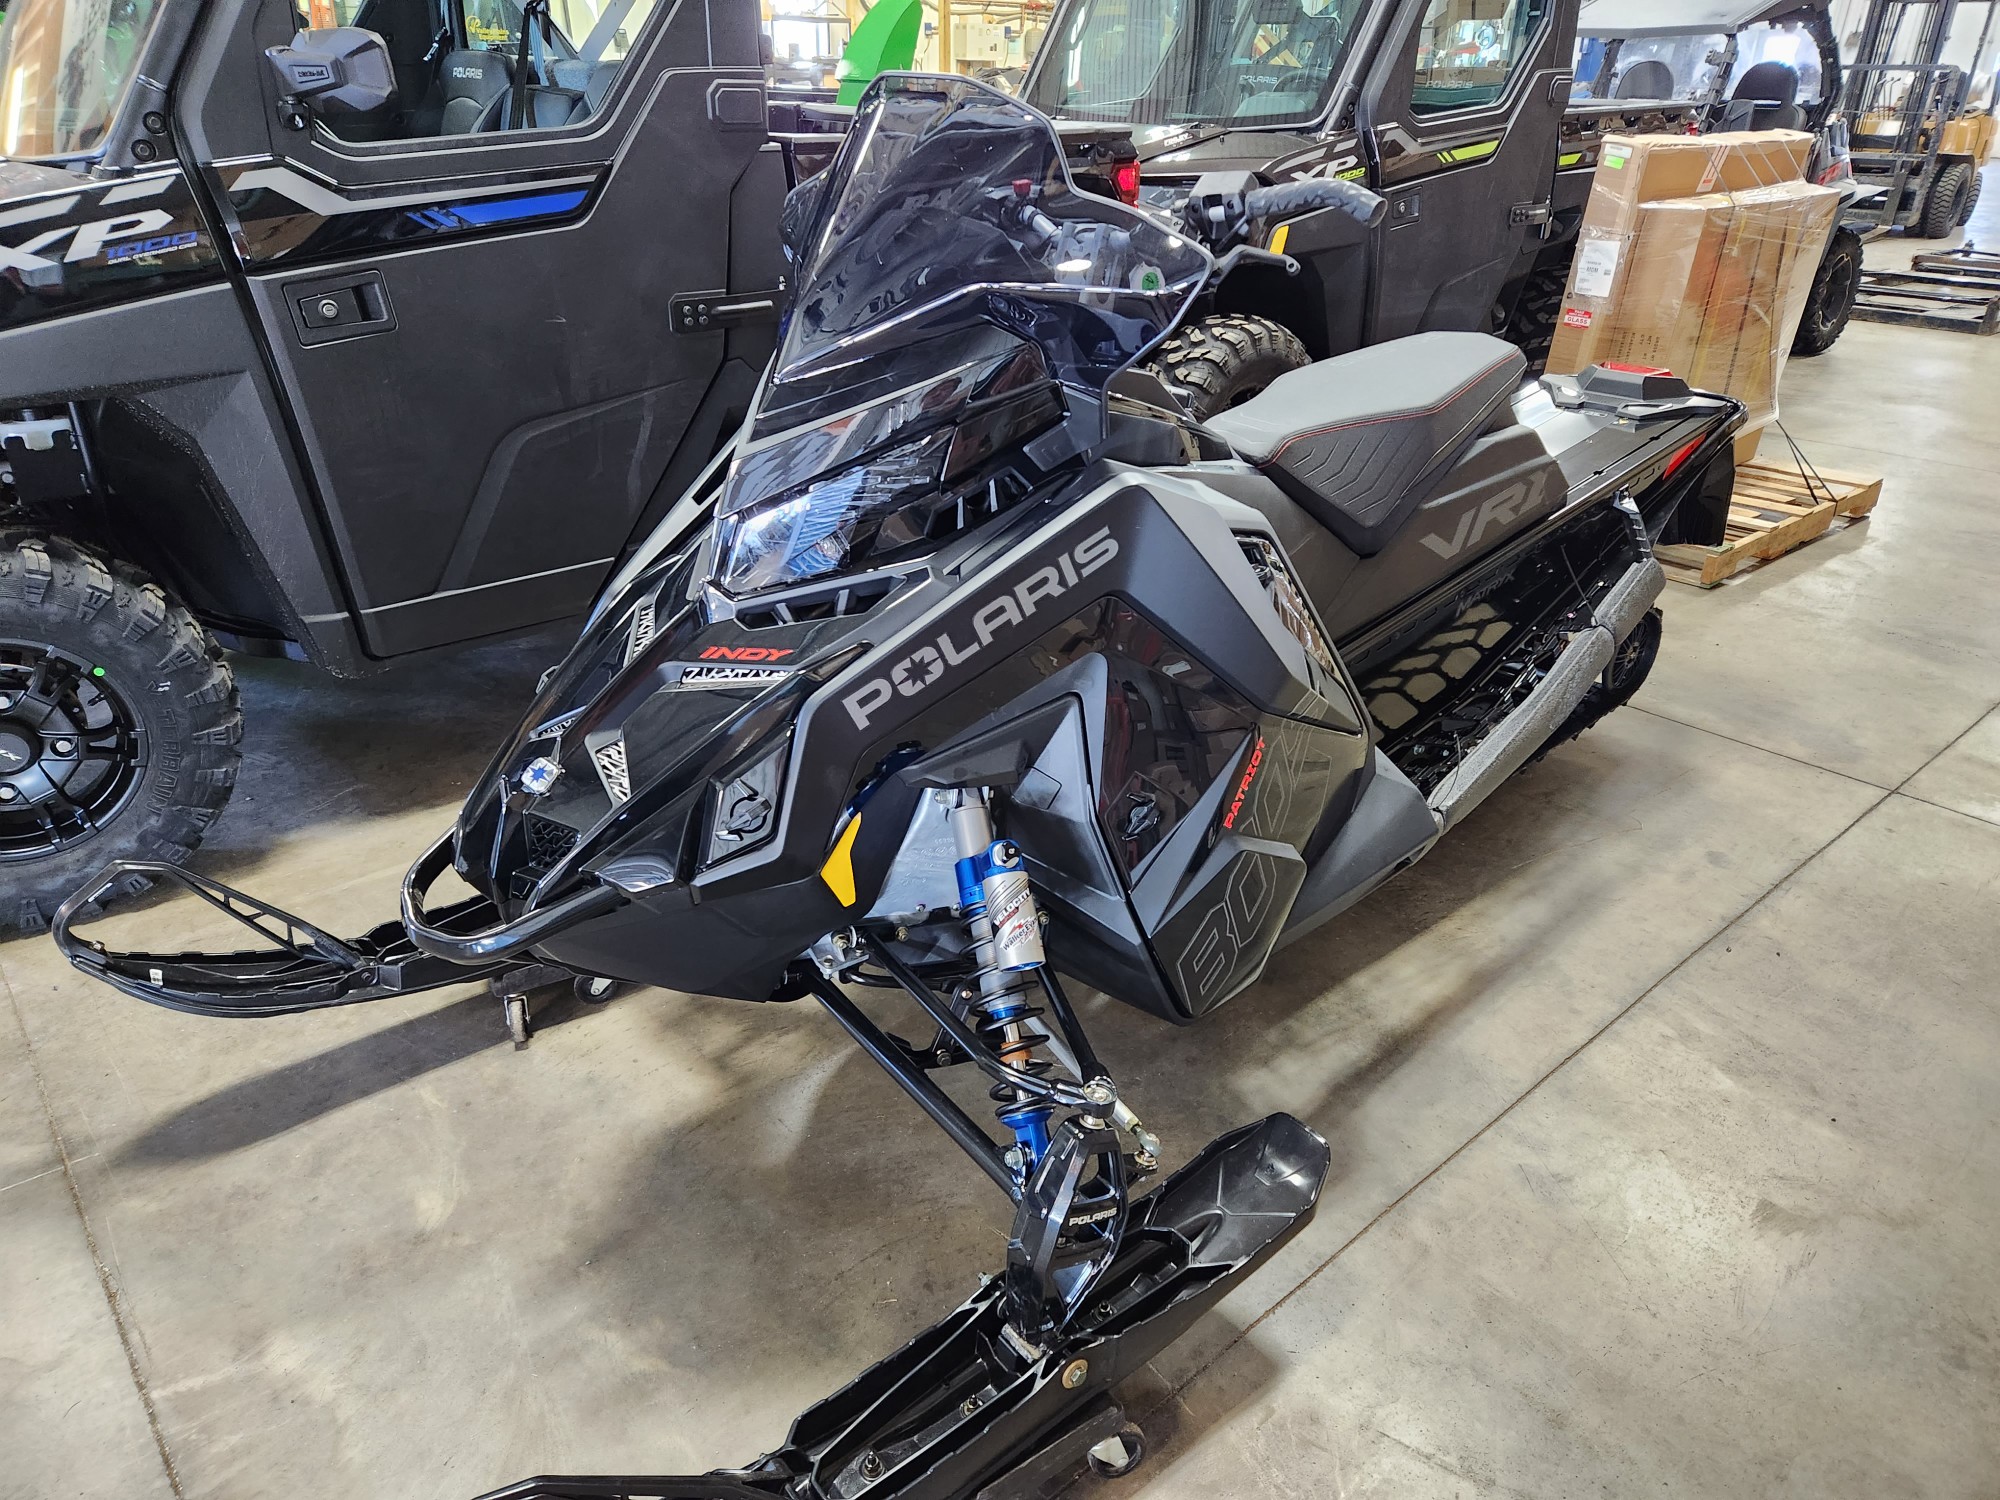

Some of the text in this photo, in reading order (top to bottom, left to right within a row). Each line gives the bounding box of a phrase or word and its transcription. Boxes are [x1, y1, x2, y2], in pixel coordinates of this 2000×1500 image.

[453, 67, 483, 79] POLARIS
[1240, 75, 1278, 84] POLARIS
[1425, 80, 1474, 89] POLARIS
[106, 231, 198, 259] 1000
[107, 256, 132, 265] DUAL
[133, 246, 178, 260] OVERHEAD
[1567, 316, 1588, 325] GLASS
[842, 525, 1119, 731] POLARIS
[699, 646, 795, 661] INDY
[1223, 735, 1266, 829] PATRIOT
[993, 887, 1031, 927] VELOCITY
[1002, 928, 1026, 951] Walker
[1068, 1207, 1117, 1226] POLARIS
